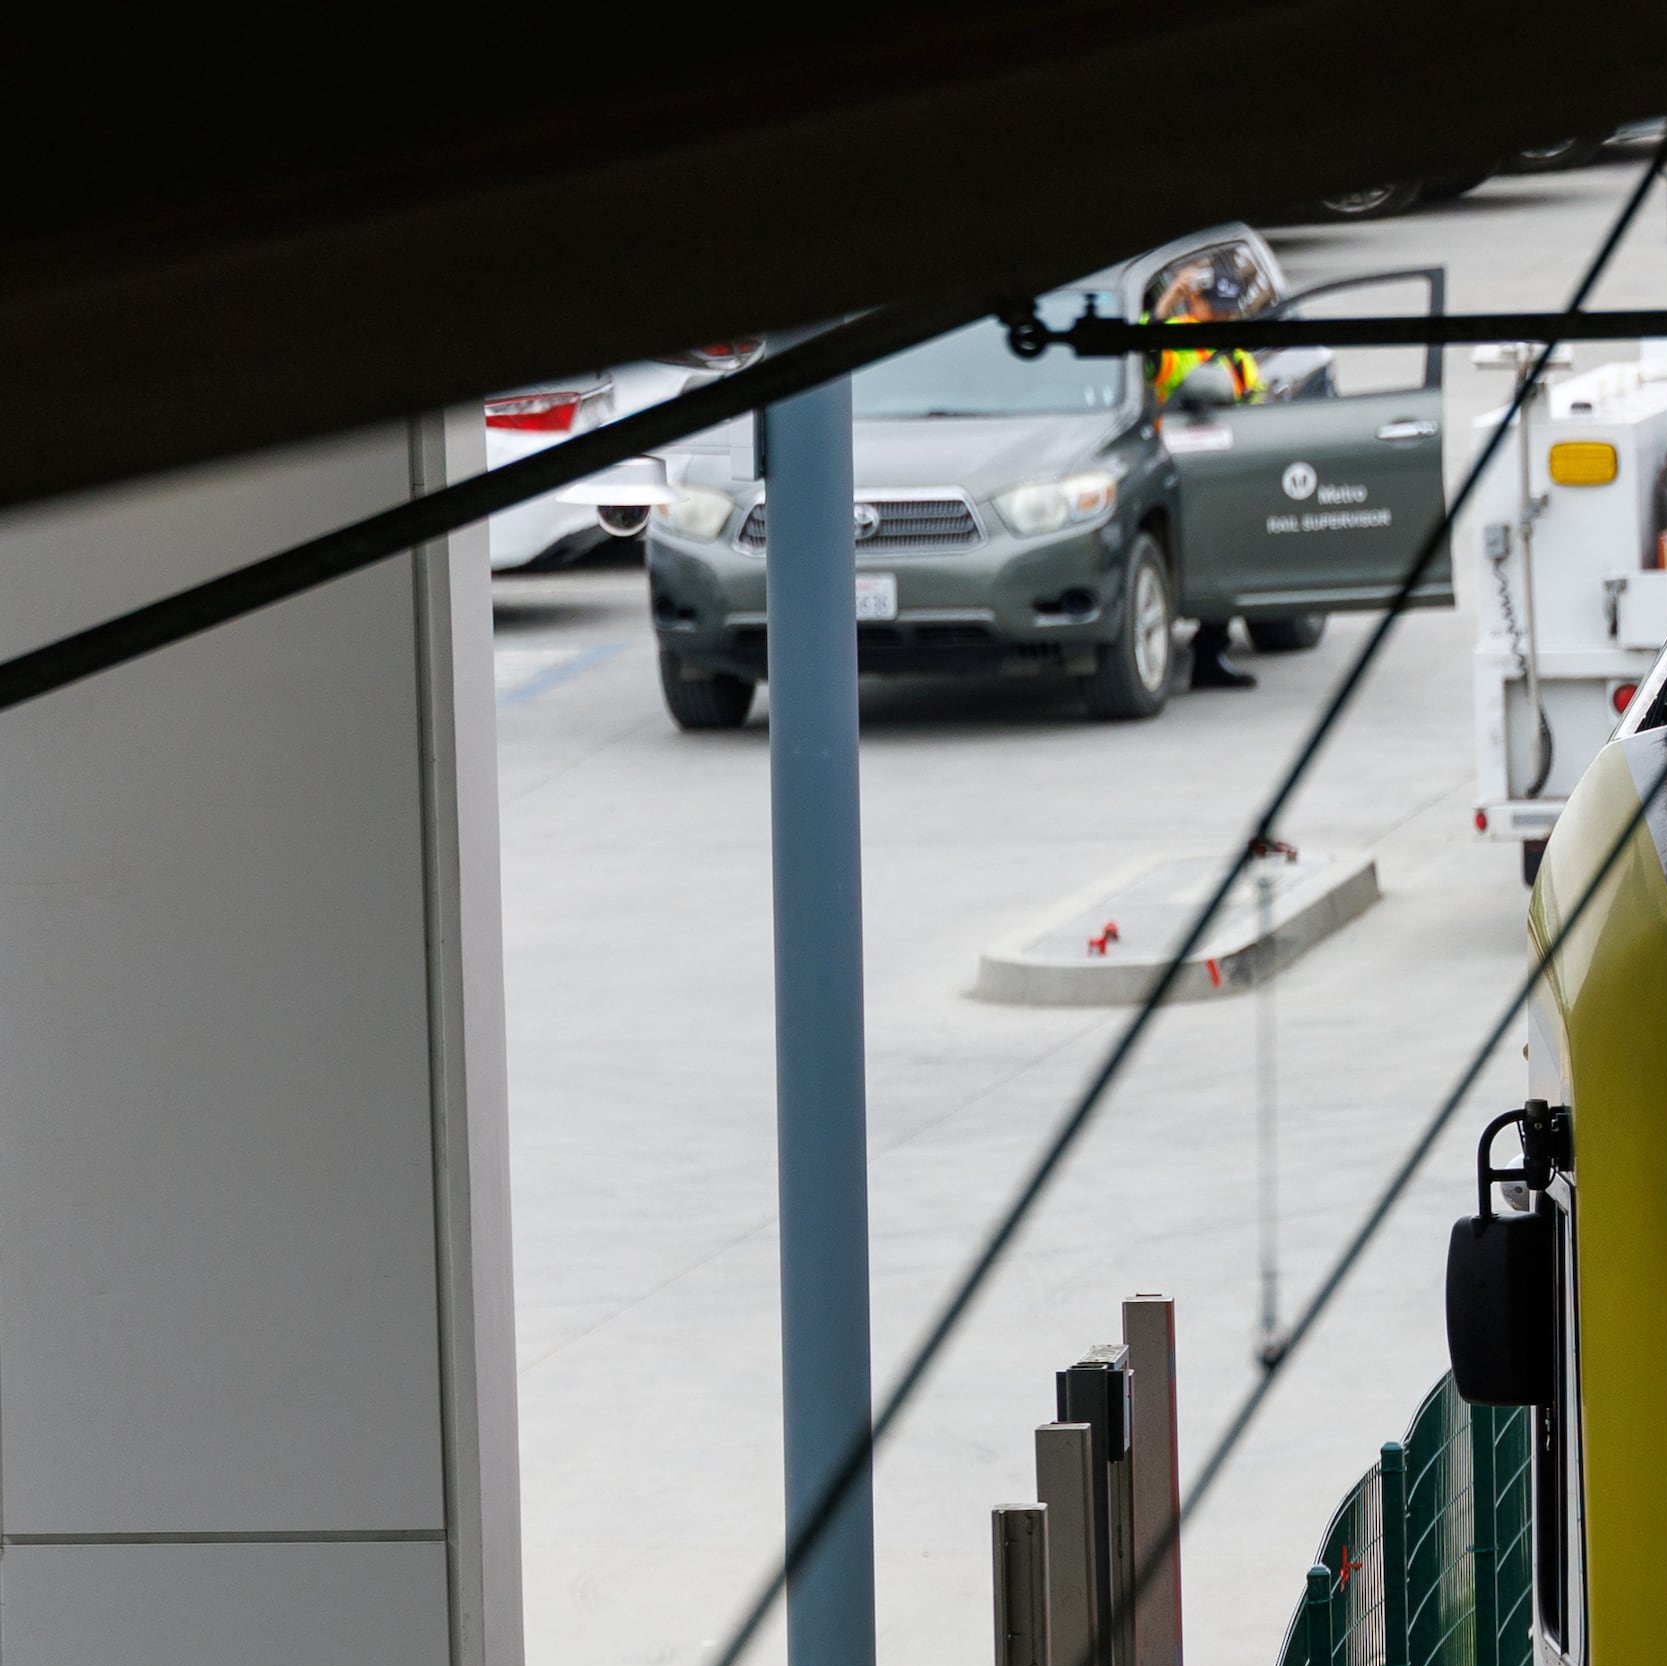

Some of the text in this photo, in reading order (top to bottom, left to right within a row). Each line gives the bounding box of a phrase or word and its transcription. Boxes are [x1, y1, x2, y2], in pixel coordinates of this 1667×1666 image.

[1318, 485, 1368, 504] Metro
[1266, 508, 1392, 534] RAIL SUPERVISOR
